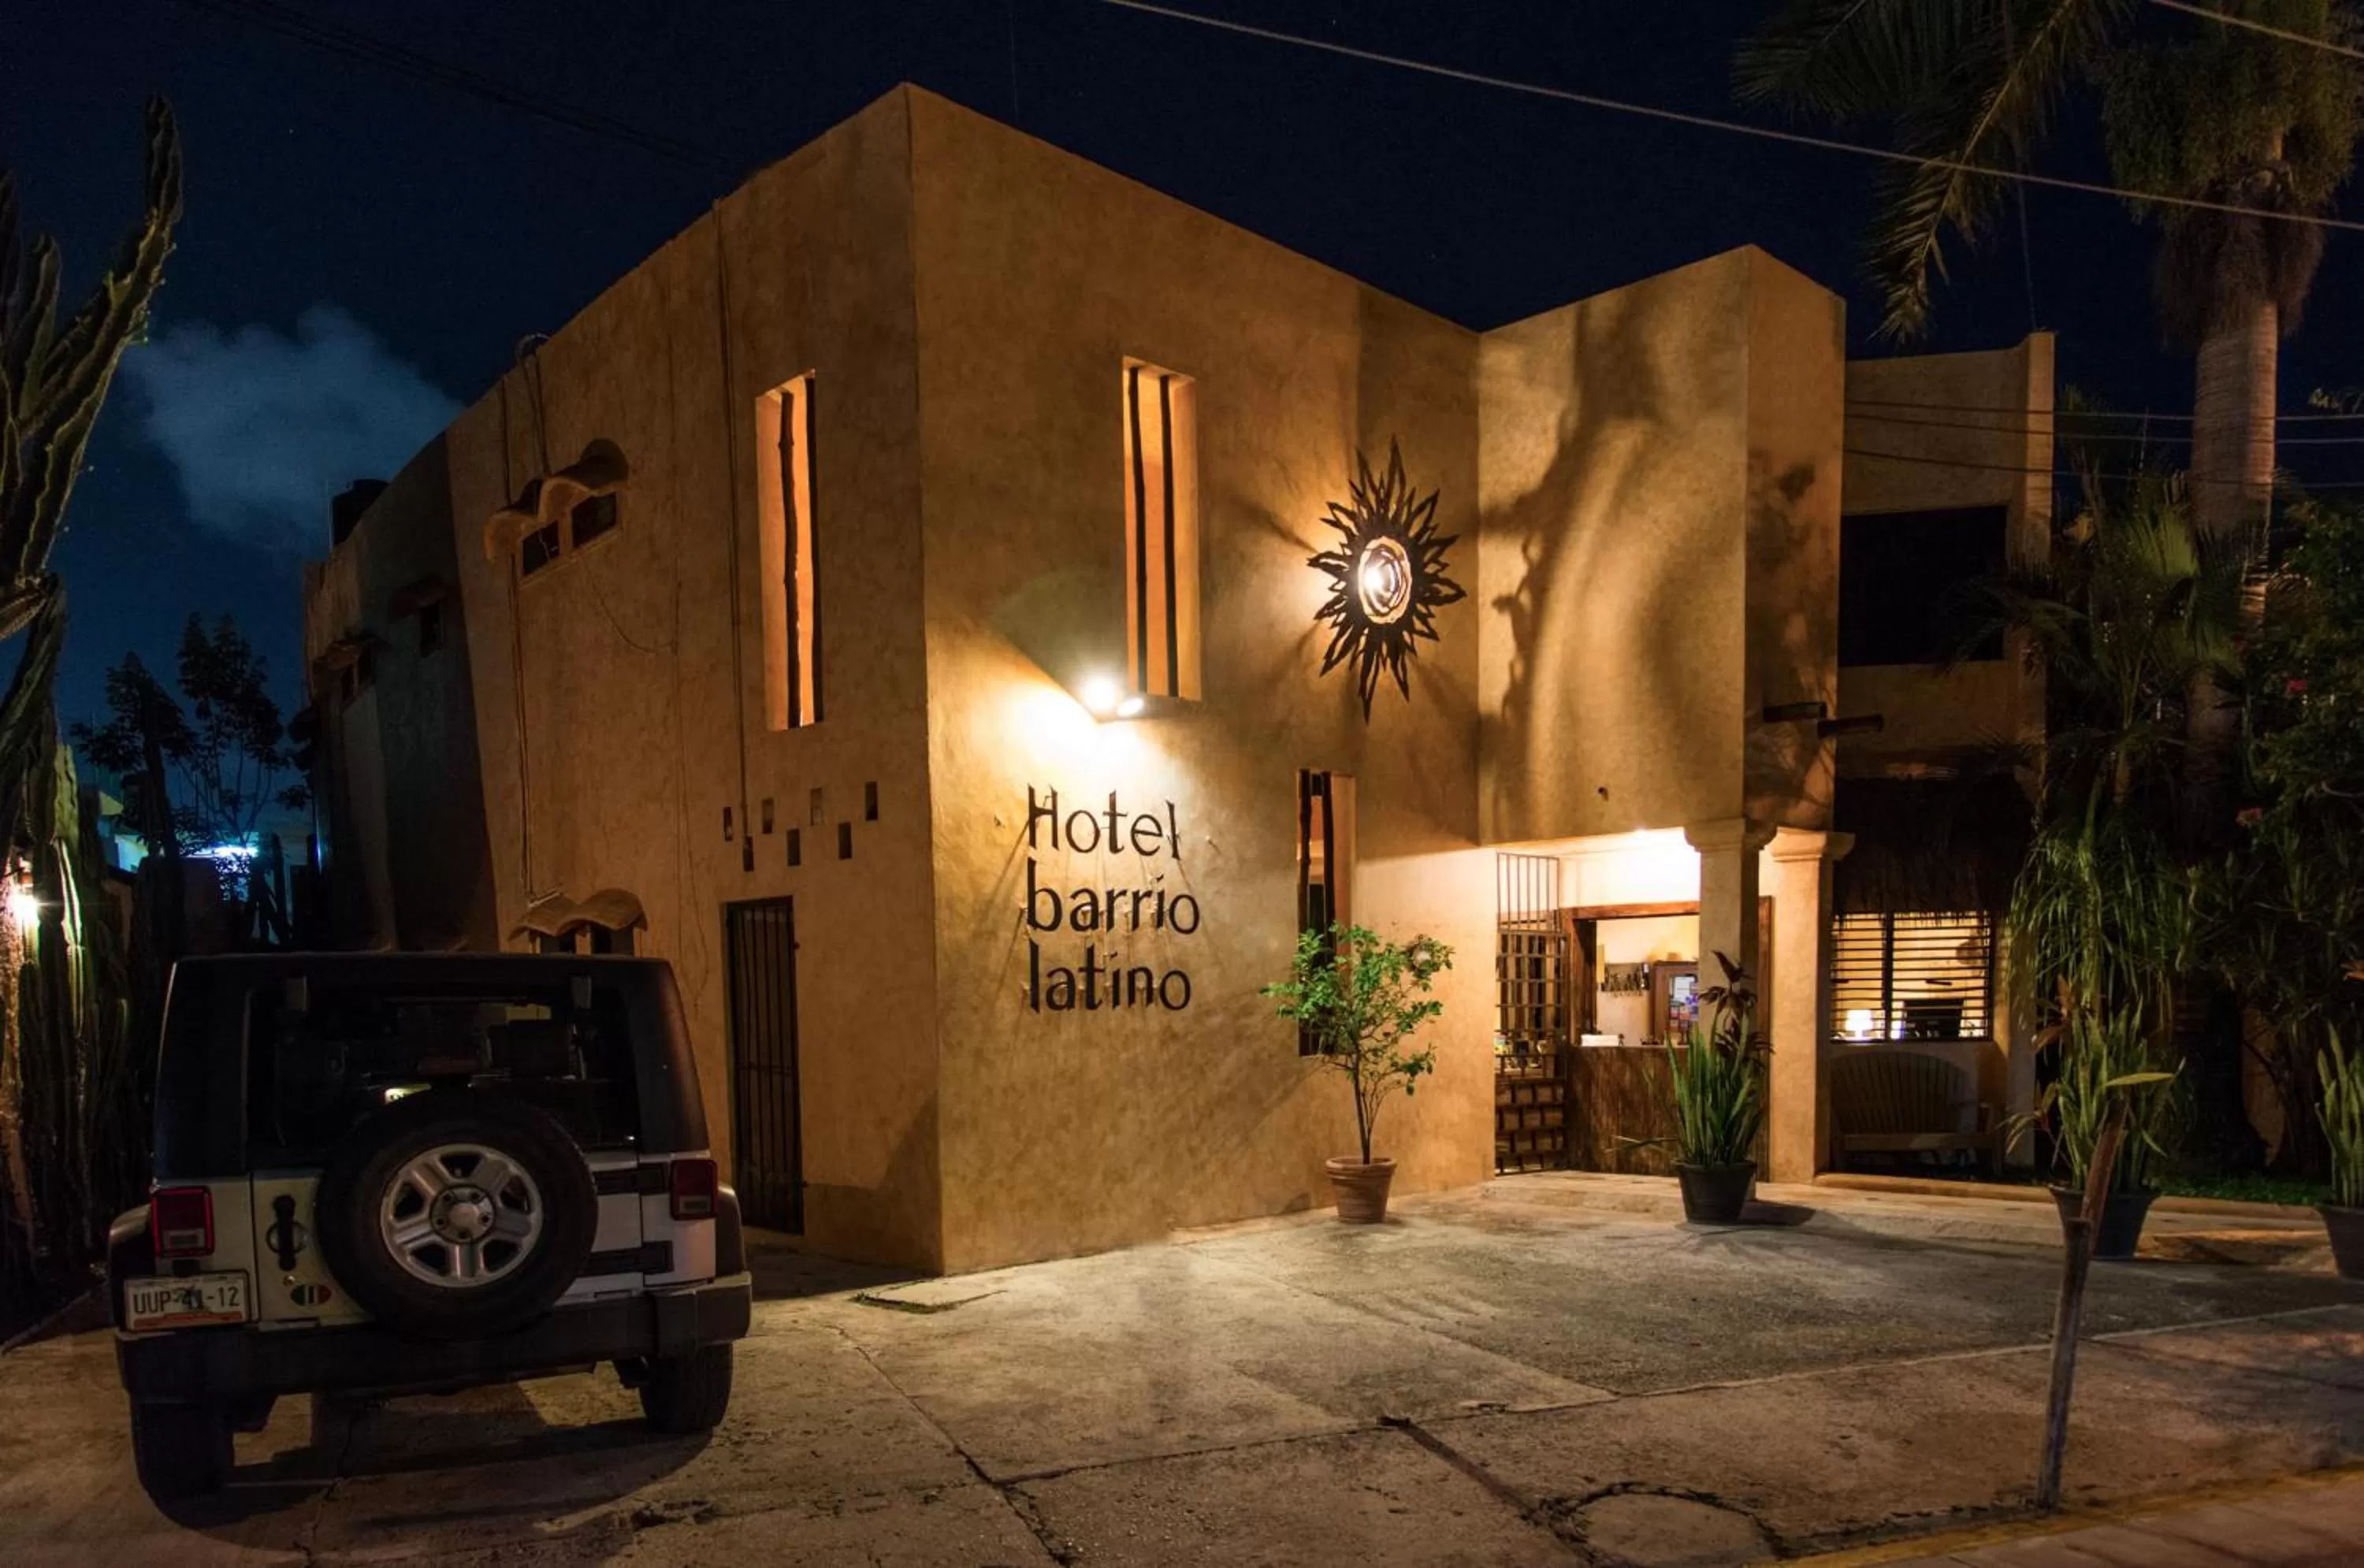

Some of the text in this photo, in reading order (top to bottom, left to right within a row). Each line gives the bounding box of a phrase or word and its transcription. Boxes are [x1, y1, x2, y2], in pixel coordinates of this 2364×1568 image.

[1028, 783, 1180, 860] Hotel
[1027, 856, 1200, 934] barrio
[1028, 937, 1191, 1013] latino
